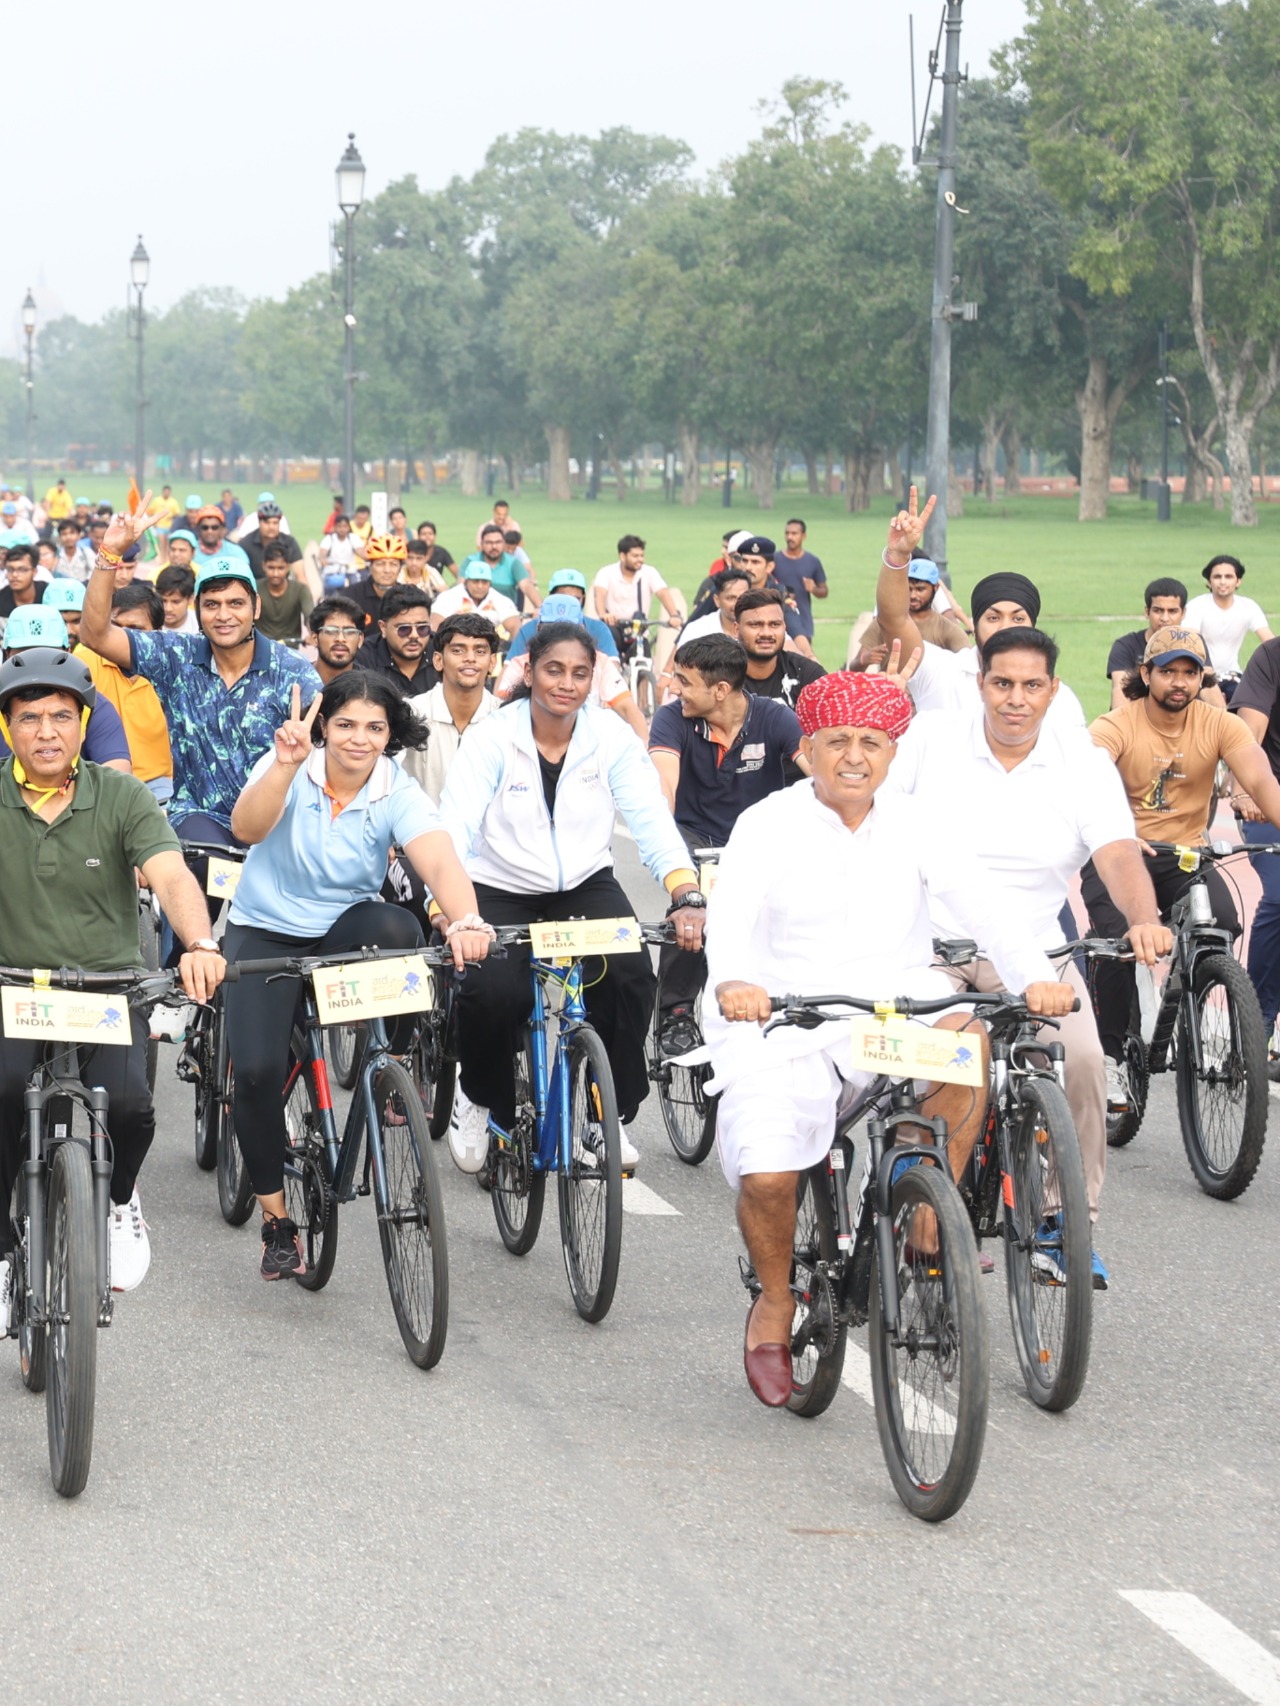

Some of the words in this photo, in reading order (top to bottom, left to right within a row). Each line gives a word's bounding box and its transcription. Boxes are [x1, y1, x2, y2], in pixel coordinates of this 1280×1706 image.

[580, 773, 599, 784] INDIA
[328, 998, 363, 1009] INDIA
[16, 1018, 55, 1027] INDIA
[863, 1050, 903, 1062] INDIA
